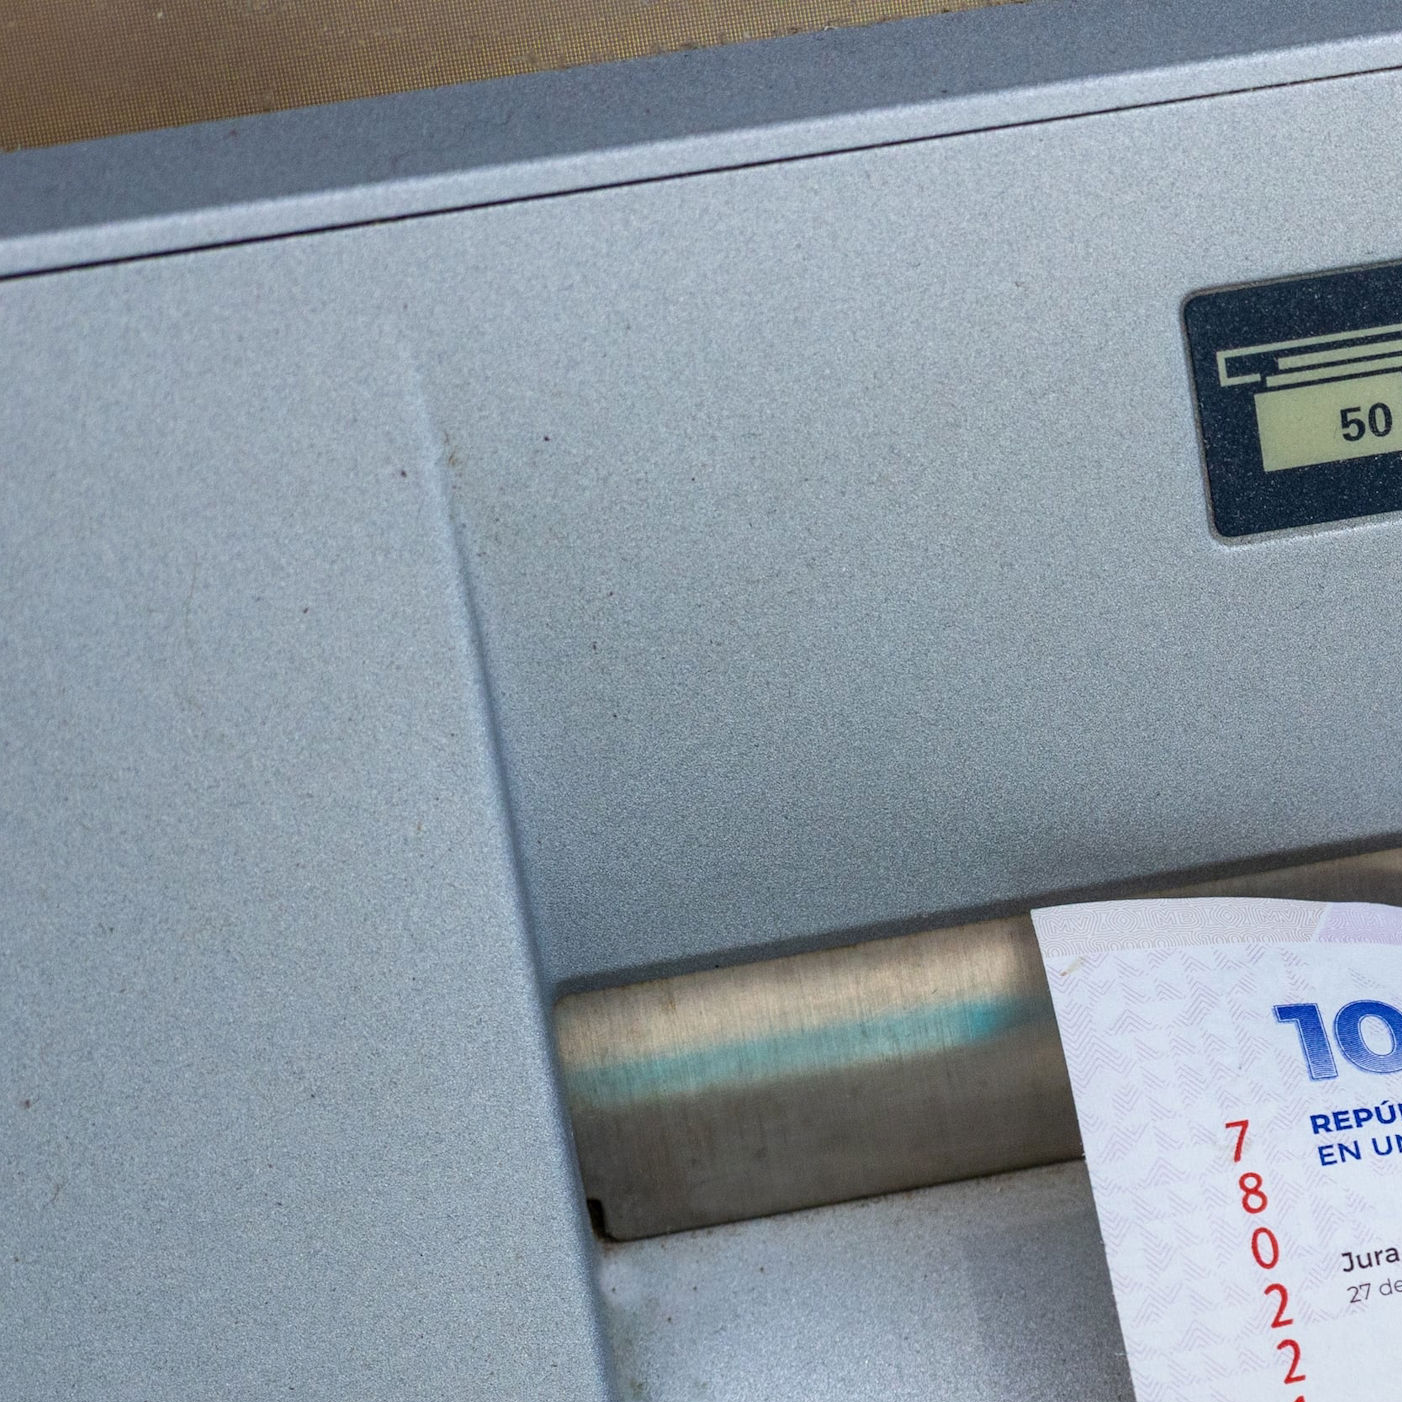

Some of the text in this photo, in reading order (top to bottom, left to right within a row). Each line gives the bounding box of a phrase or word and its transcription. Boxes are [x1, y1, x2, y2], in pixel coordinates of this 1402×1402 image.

[1338, 402, 1394, 443] 50
[1317, 1141, 1363, 1167] EN
[1340, 1245, 1401, 1273] Jura
[1346, 1282, 1372, 1305] 27
